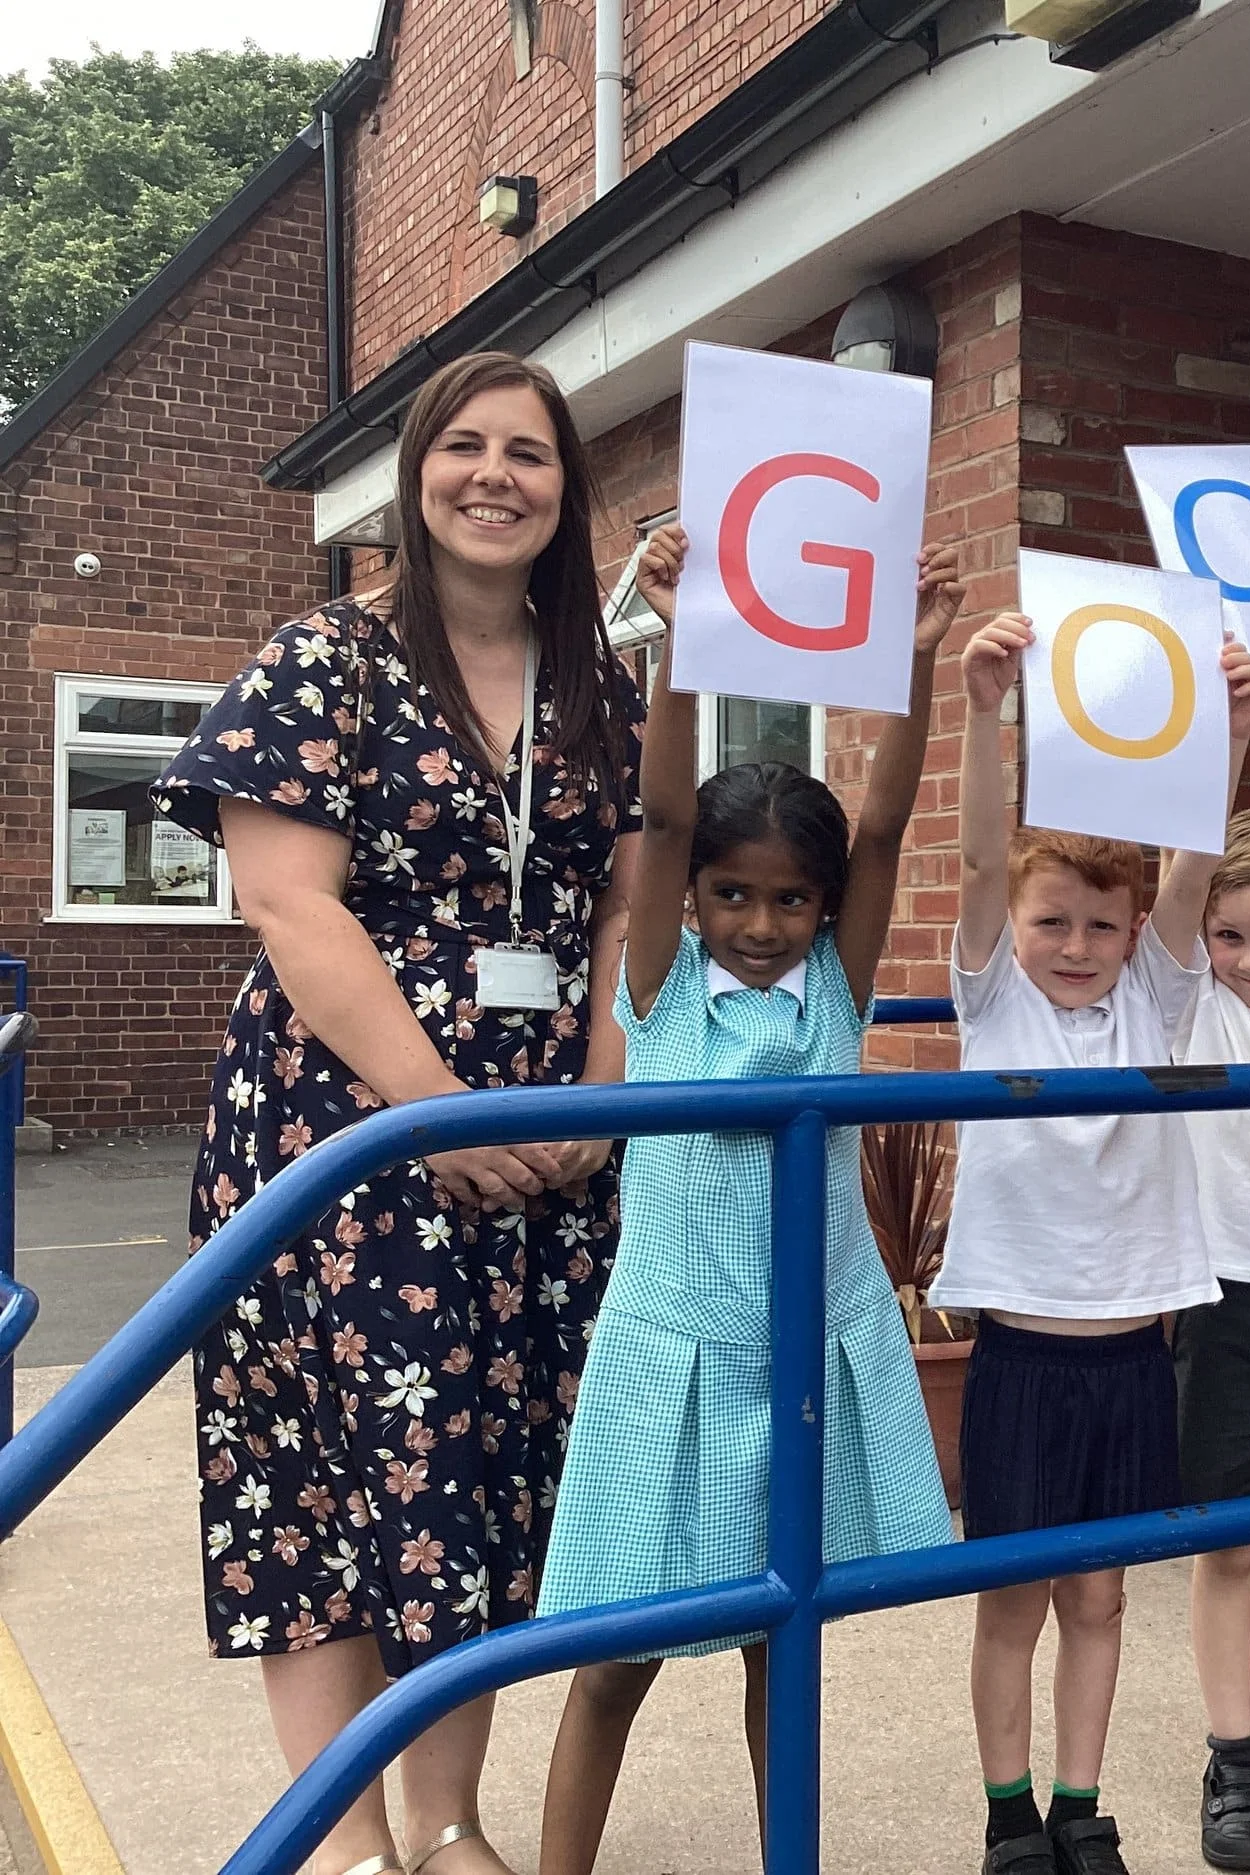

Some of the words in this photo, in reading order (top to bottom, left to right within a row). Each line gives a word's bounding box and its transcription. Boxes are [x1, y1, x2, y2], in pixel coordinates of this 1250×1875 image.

[718, 453, 880, 652] G
[1052, 604, 1196, 761] O
[155, 833, 181, 841] APPLY
[182, 834, 201, 842] NO
